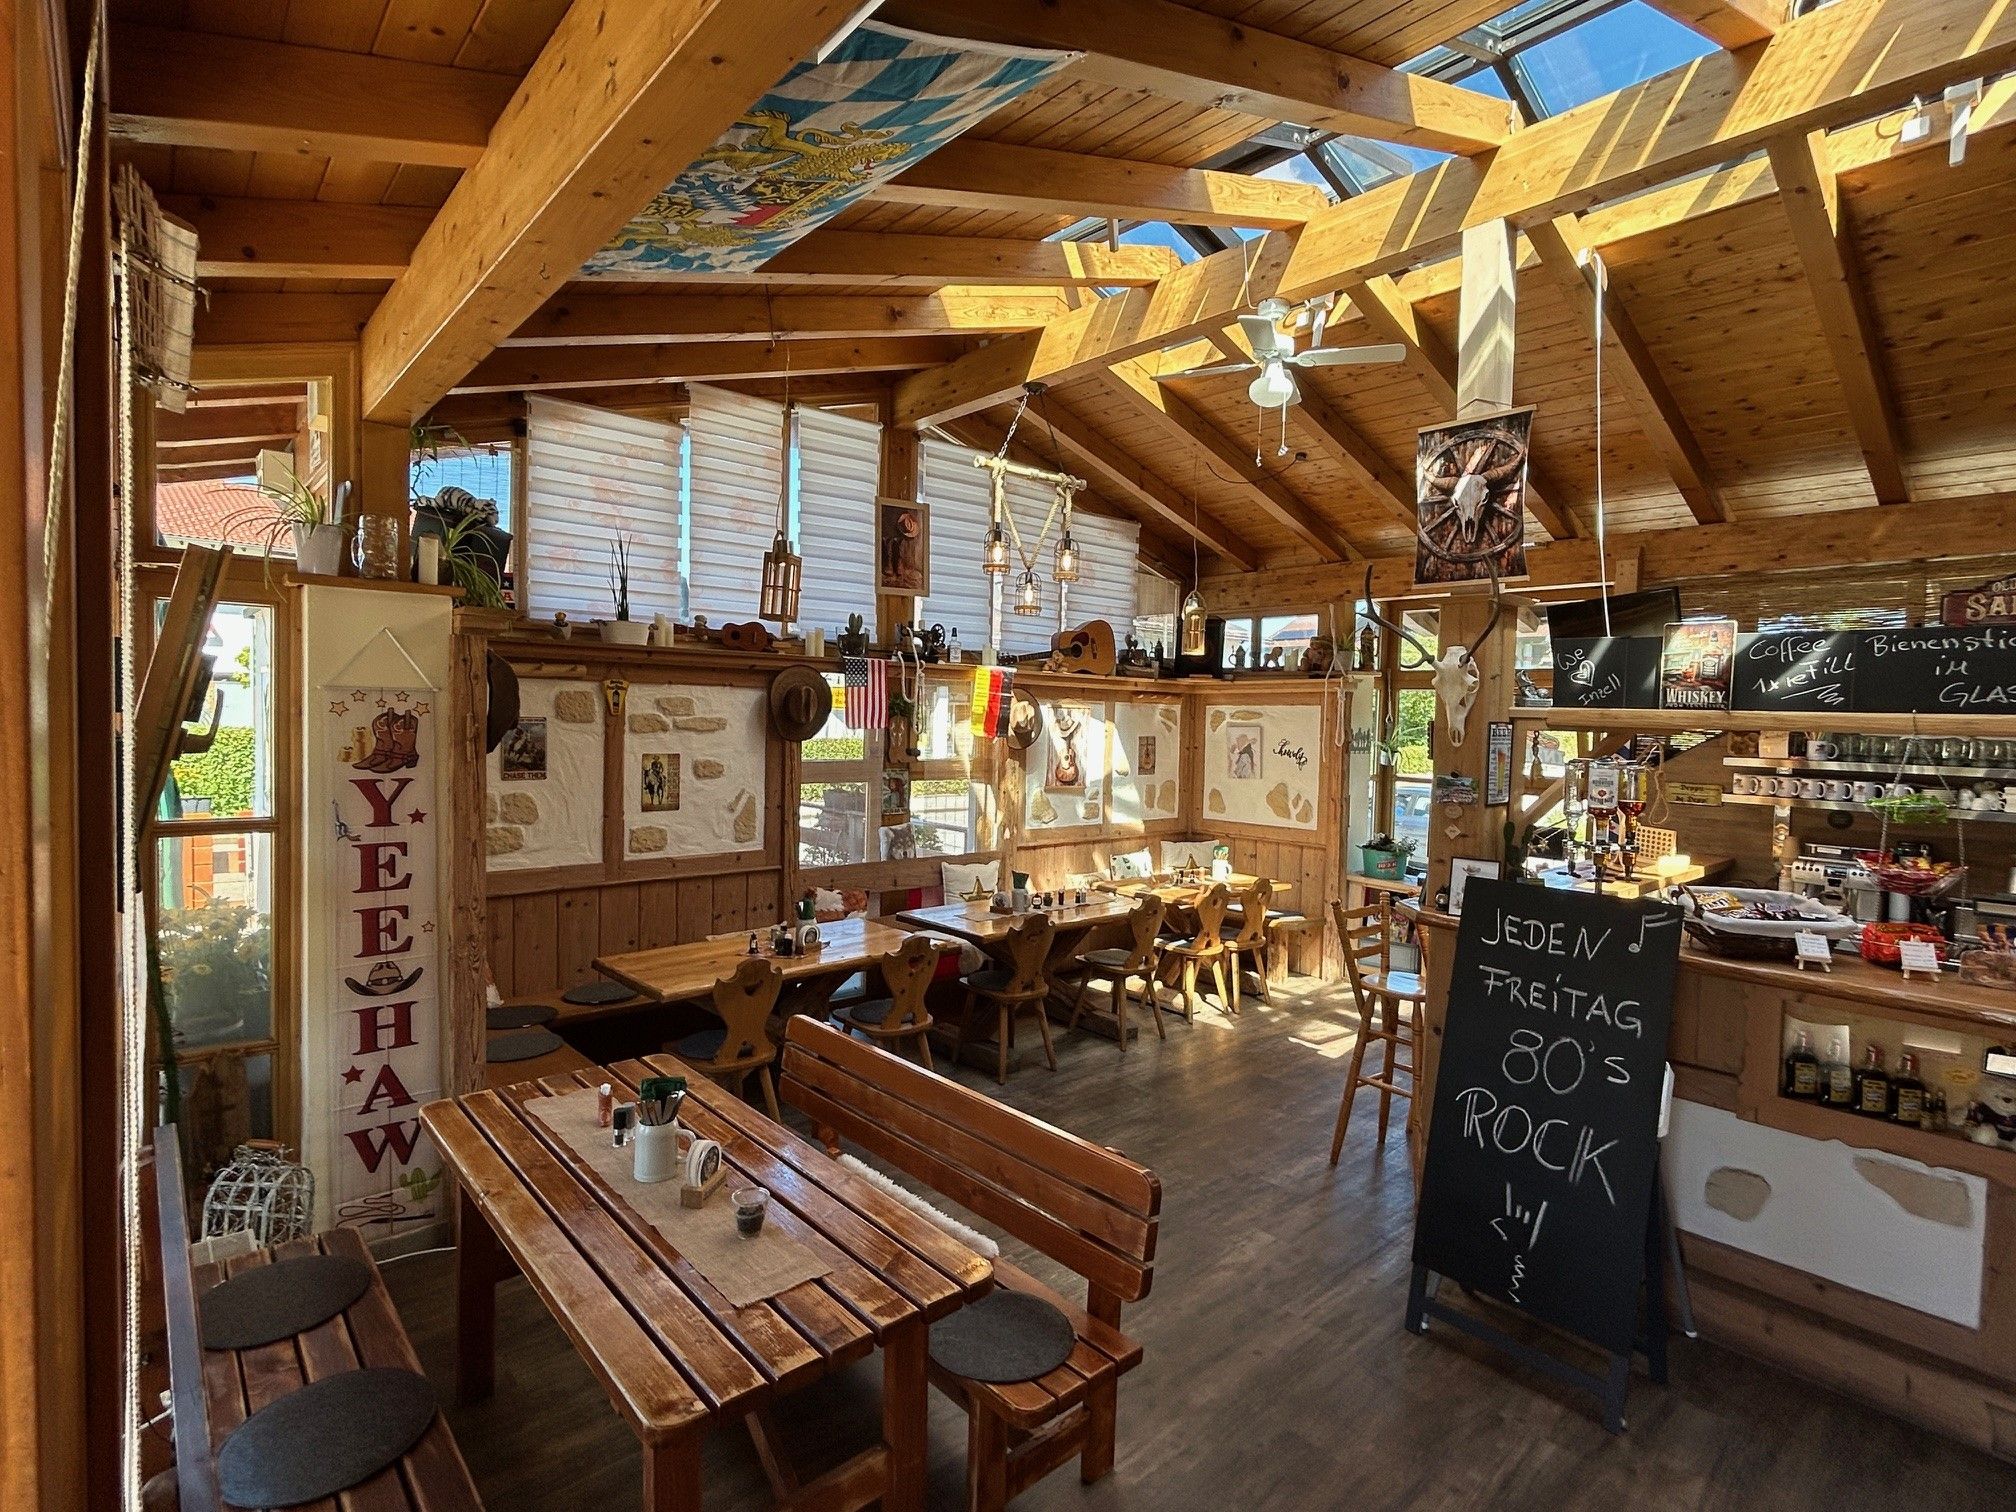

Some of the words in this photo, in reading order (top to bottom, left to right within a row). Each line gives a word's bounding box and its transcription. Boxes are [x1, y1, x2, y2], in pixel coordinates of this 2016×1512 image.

[1557, 648, 1585, 671] We
[1749, 636, 1831, 663] Coffee
[1578, 673, 1621, 706] Inzell
[1666, 688, 1726, 703] WHISKEY
[1480, 908, 1612, 960] JEDEN
[1501, 1028, 1631, 1095] 80's
[1455, 1086, 1620, 1206] ROCK
